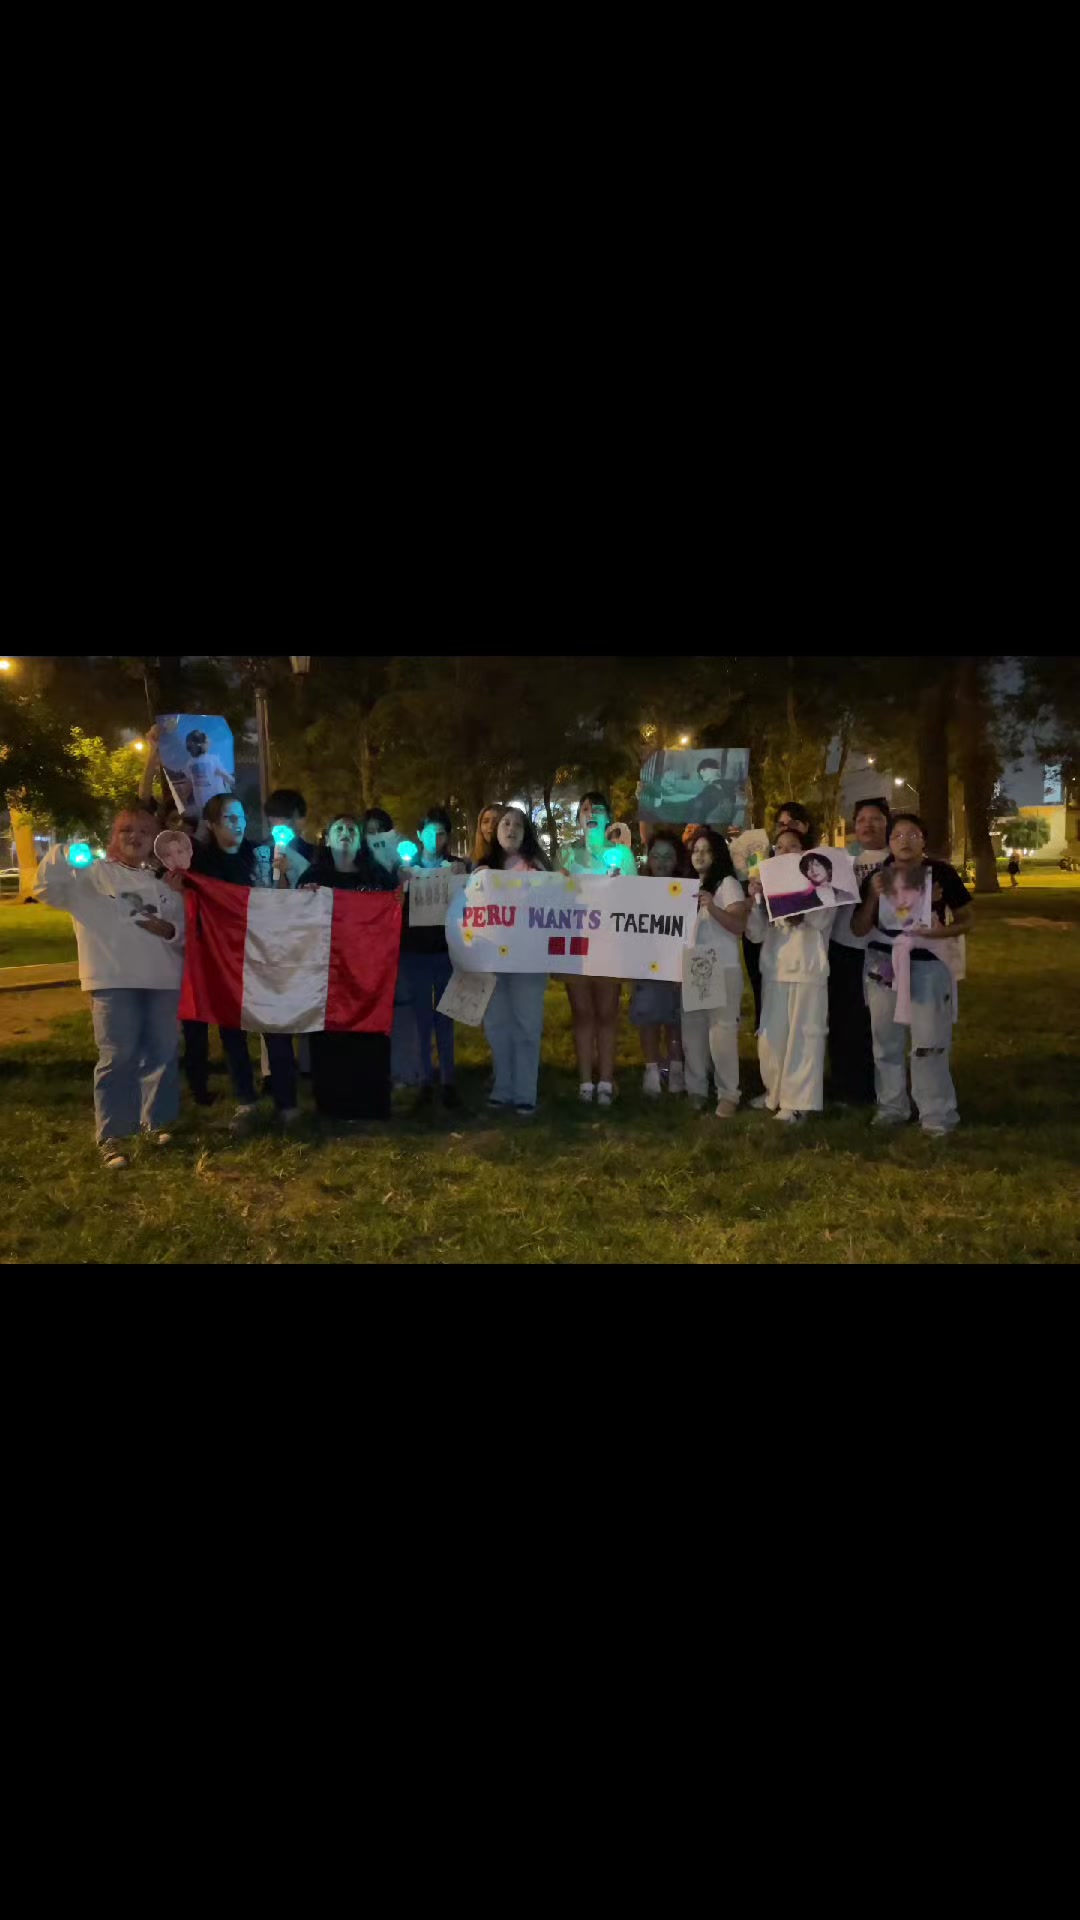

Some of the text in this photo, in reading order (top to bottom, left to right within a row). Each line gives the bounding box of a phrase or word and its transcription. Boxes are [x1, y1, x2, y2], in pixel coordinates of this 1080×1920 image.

[462, 904, 684, 937] PERU WANTS TAEMIN
